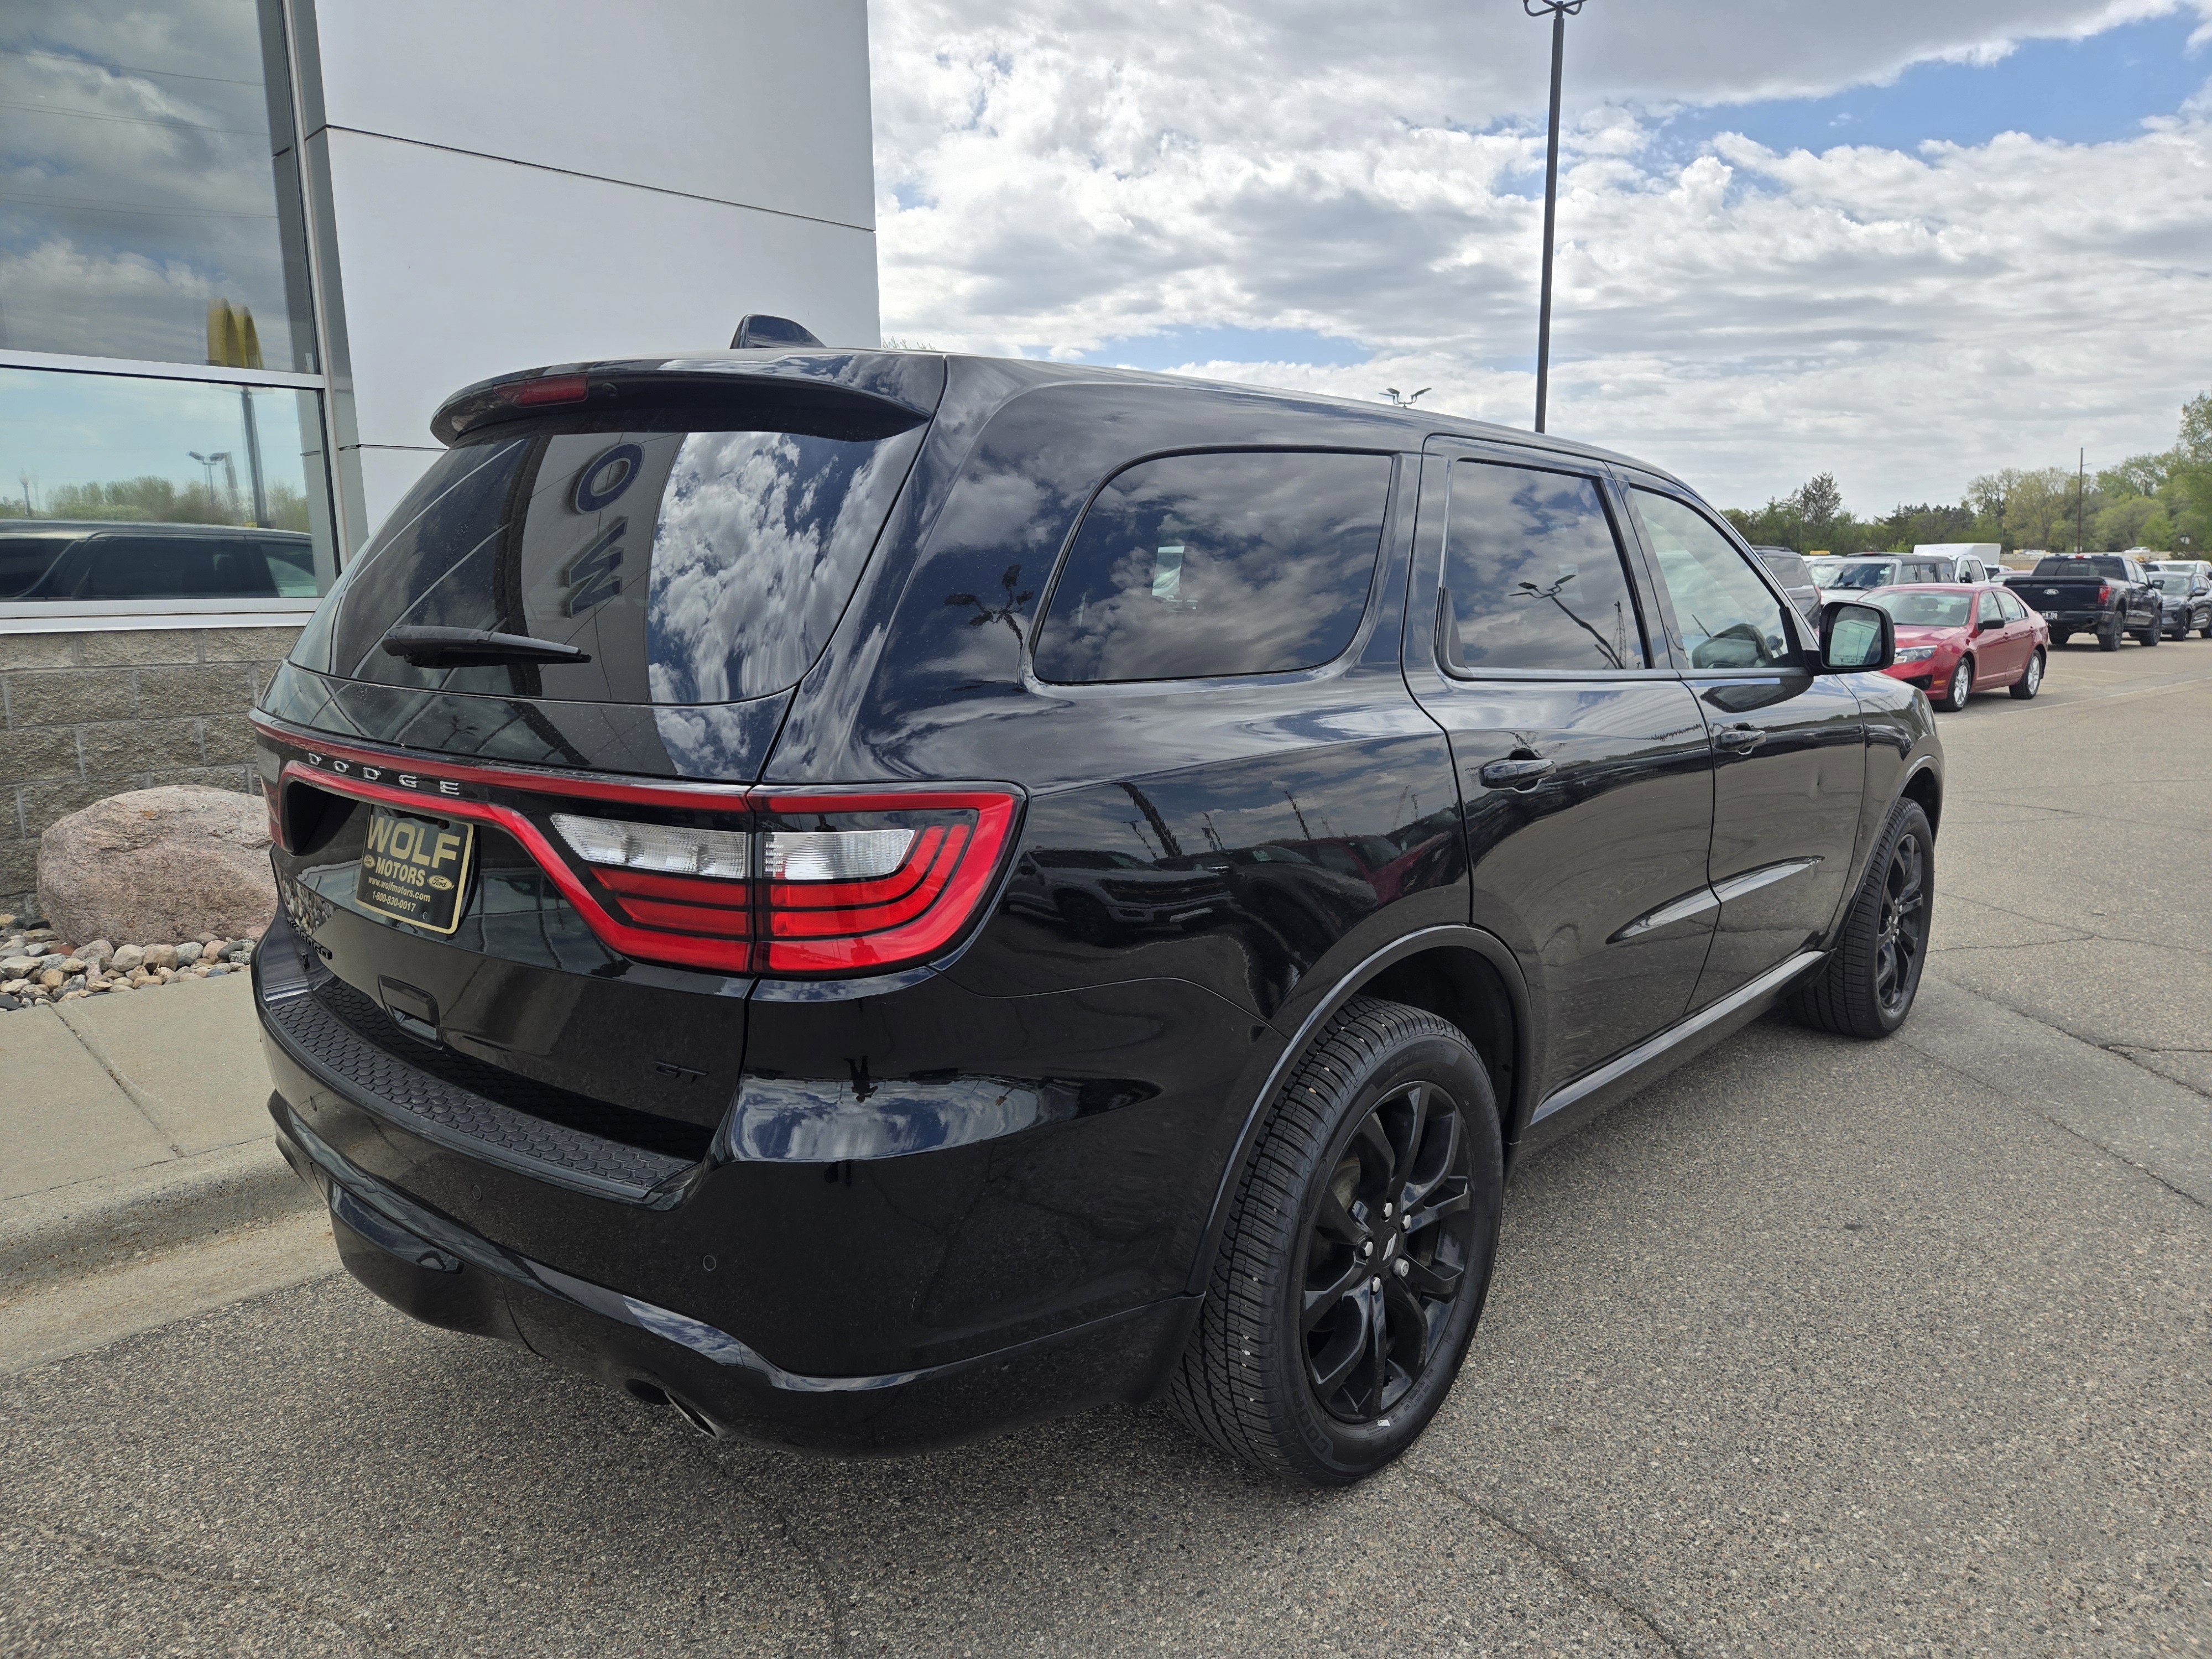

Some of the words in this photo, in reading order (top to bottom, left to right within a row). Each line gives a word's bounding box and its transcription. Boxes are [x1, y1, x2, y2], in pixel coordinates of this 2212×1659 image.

[308, 753, 460, 795] DODGE
[367, 815, 461, 869] WOLF
[375, 857, 426, 887] MOTORS
[368, 876, 431, 902] www.wolfmotors.com
[372, 890, 416, 912] 1-800-830-0017
